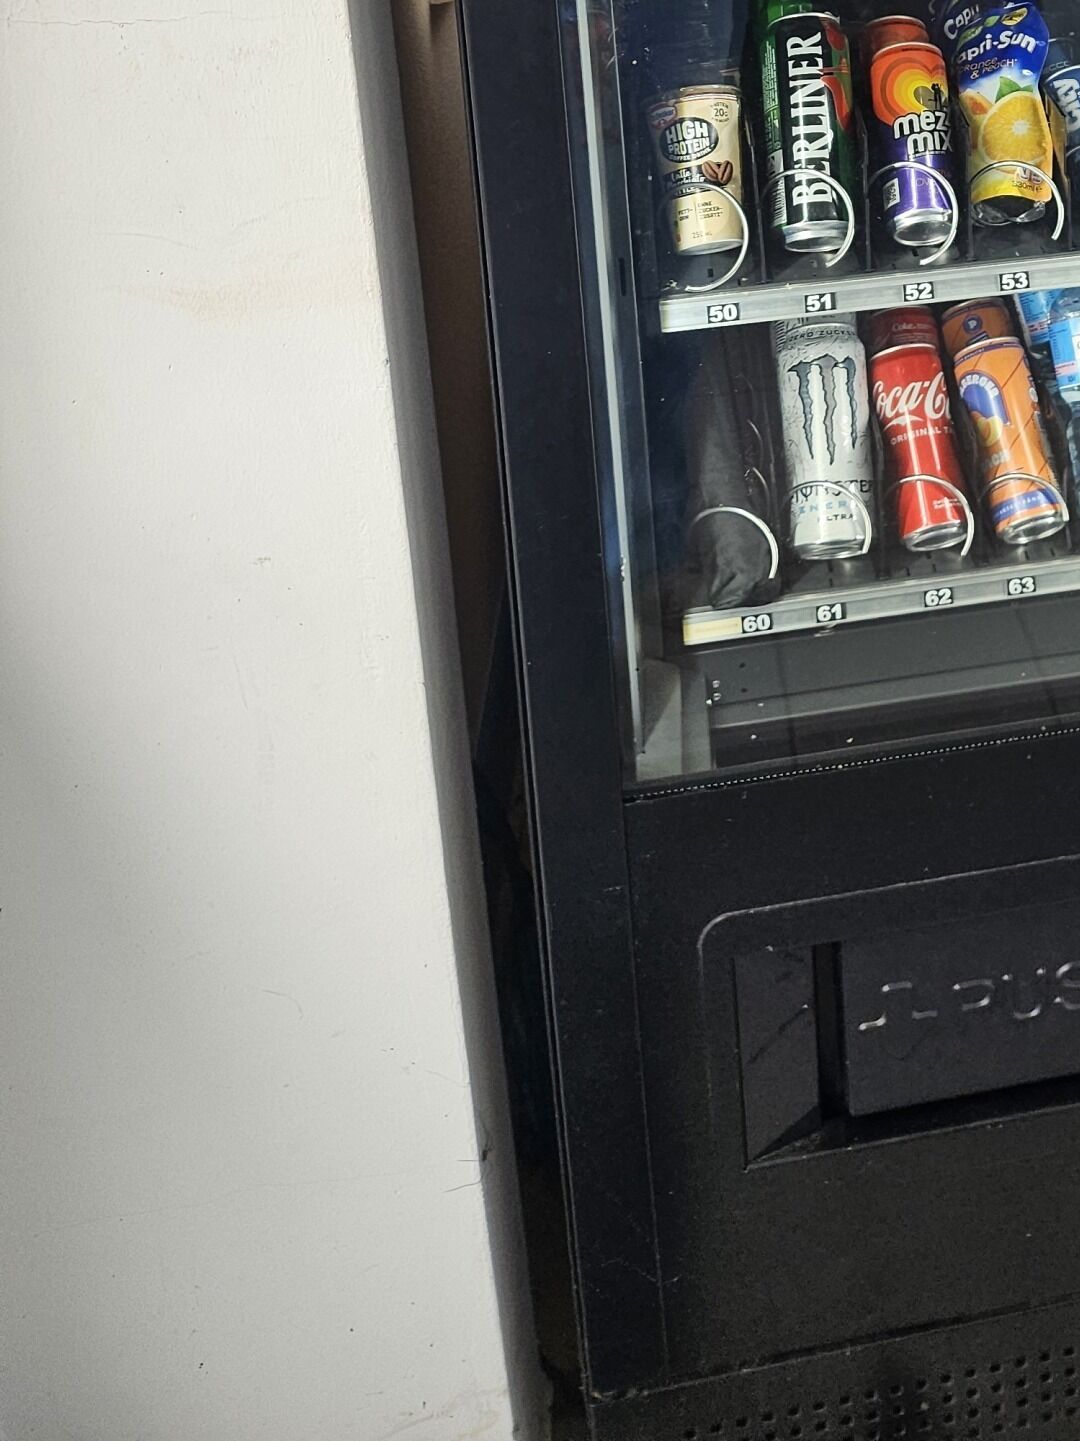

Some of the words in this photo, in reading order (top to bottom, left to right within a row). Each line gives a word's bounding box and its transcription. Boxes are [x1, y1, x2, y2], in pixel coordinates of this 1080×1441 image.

[665, 120, 709, 143] HIGH
[667, 137, 711, 155] PROTEIN
[906, 131, 953, 159] mix
[1001, 272, 1028, 289] 53
[904, 284, 933, 301] 52
[806, 294, 833, 311] 51
[709, 304, 738, 321] 50
[1008, 578, 1034, 595] 63
[925, 589, 952, 606] 62
[817, 604, 842, 622] 61
[743, 615, 771, 632] 60
